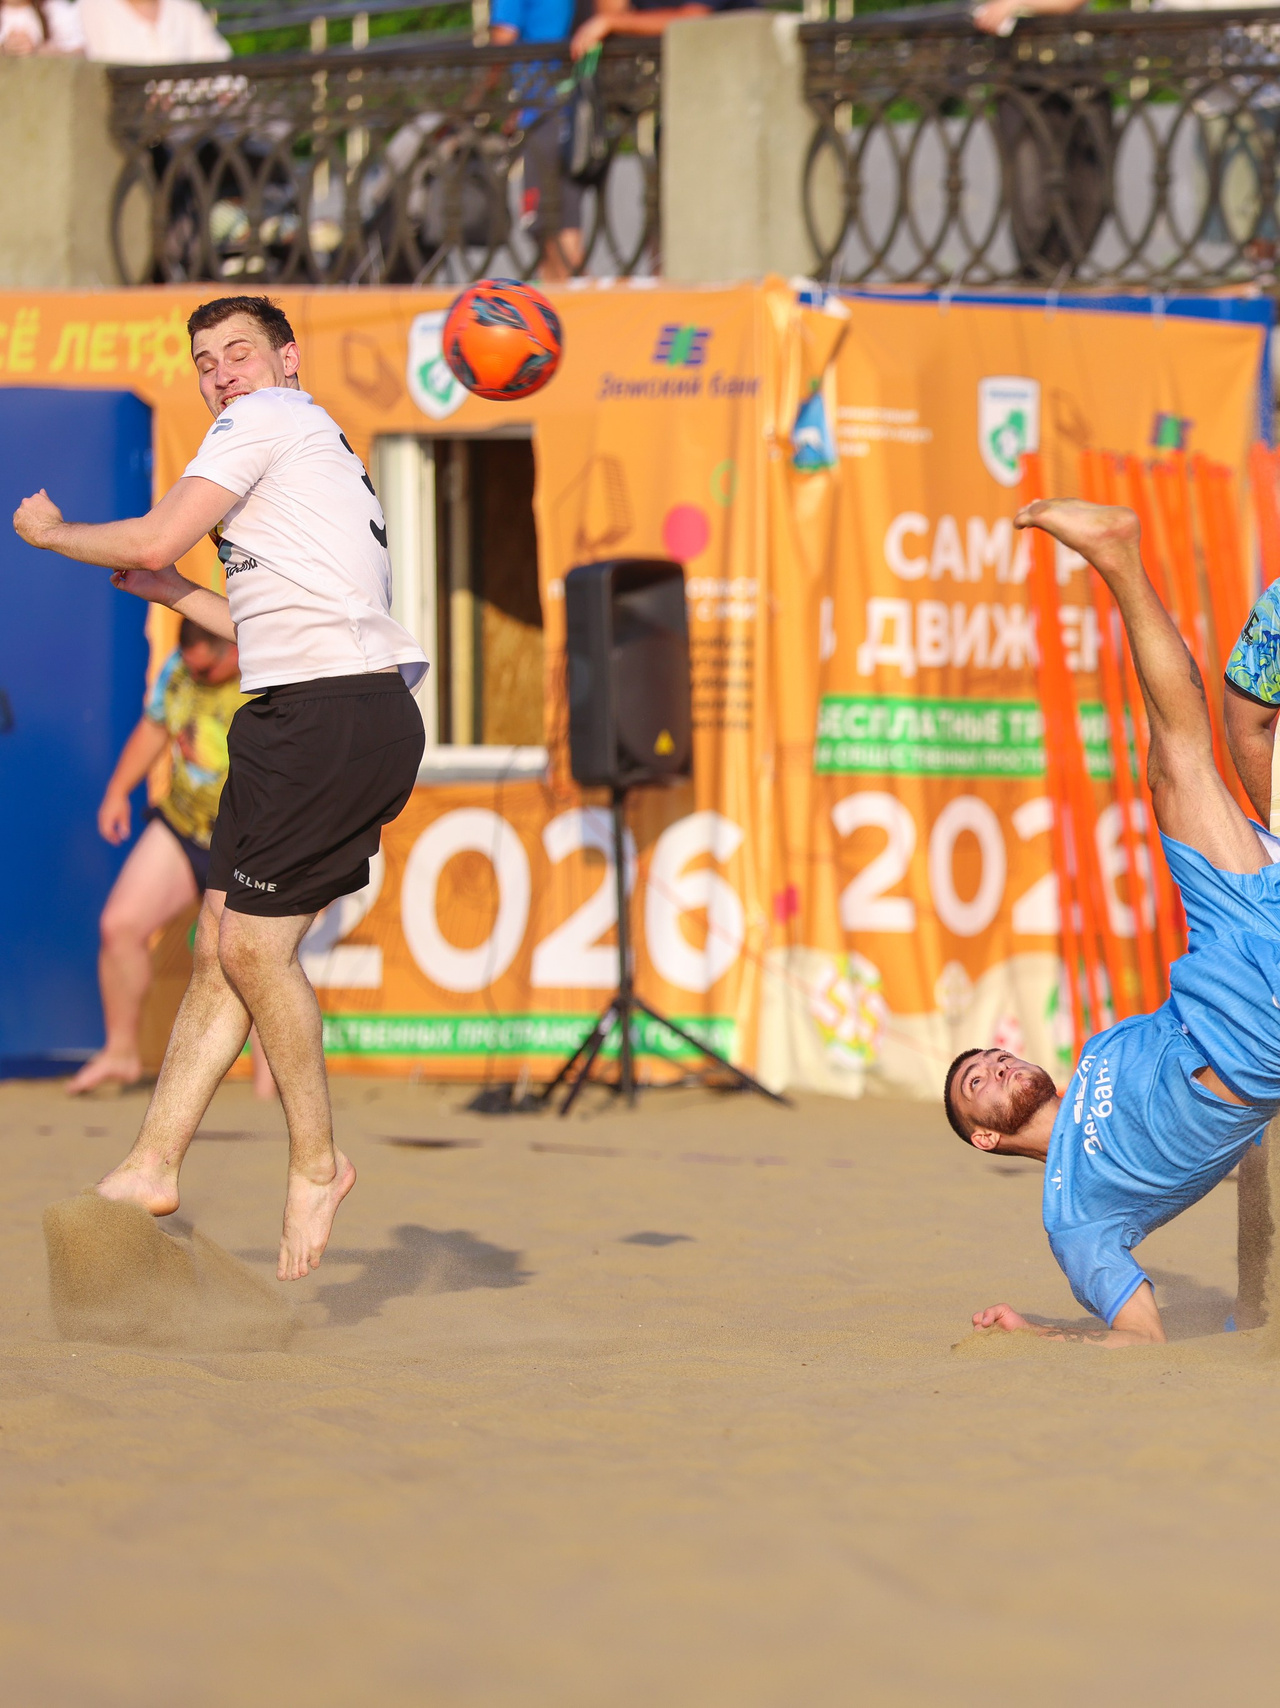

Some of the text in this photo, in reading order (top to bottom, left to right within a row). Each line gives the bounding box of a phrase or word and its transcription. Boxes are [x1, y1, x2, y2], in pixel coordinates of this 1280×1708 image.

[884, 511, 1092, 588] САМР
[856, 597, 1120, 679] ДВИЖЕН
[233, 868, 277, 893] KELME
[303, 806, 747, 993] 2026
[831, 789, 1157, 938] 2026
